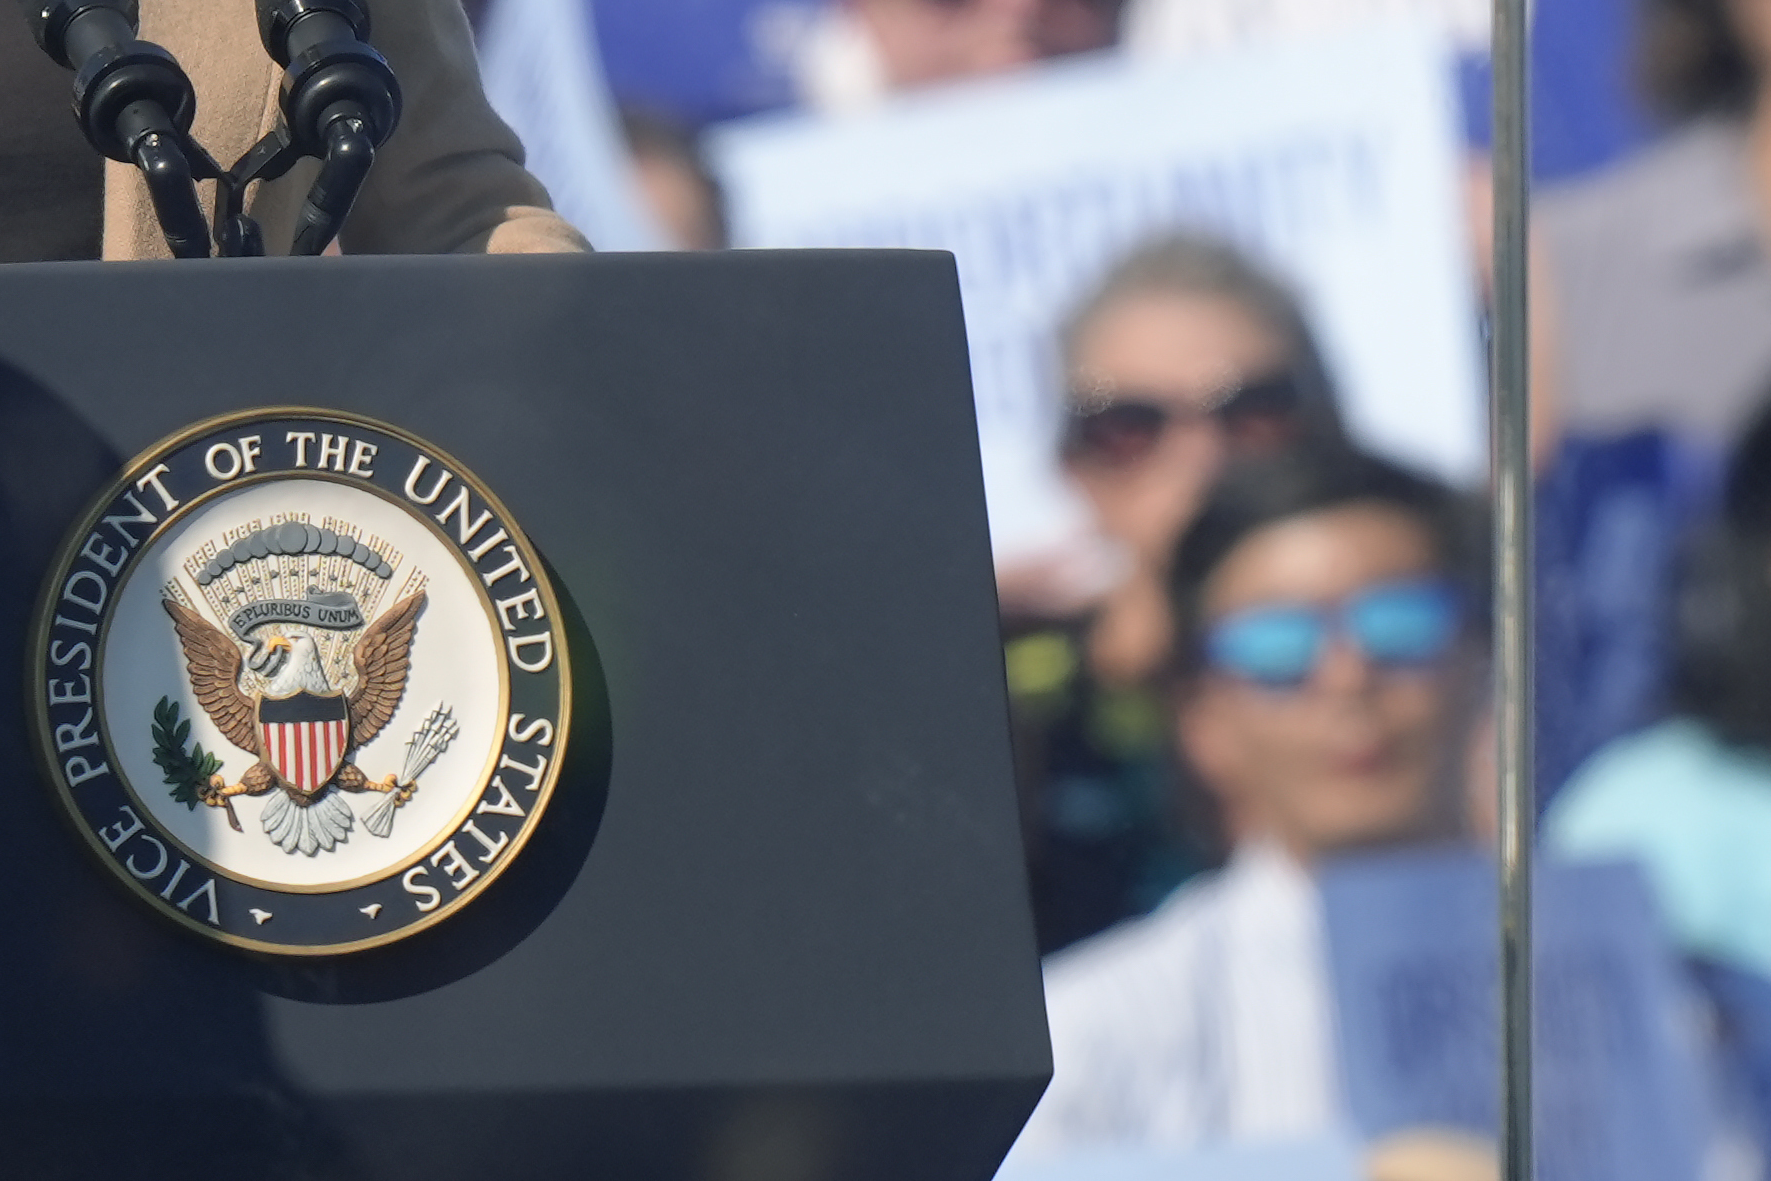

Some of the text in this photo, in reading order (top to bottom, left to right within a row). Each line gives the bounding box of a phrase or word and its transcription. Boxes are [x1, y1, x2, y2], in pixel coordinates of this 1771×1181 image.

[49, 431, 554, 926] VICE PRESIDENT OF THE UNITED STATES
[234, 603, 359, 628] E PLURIBUS UNUM
